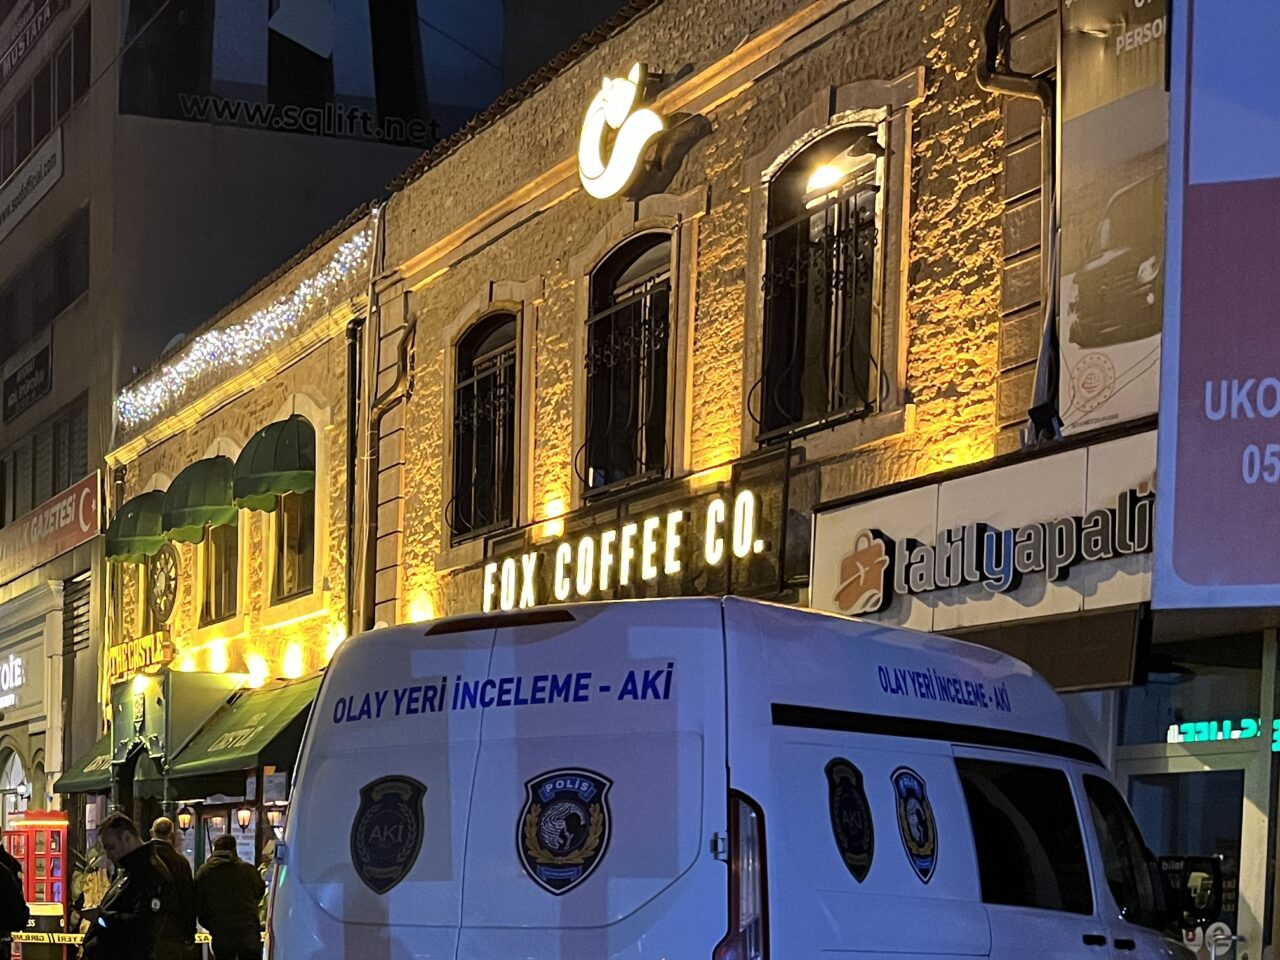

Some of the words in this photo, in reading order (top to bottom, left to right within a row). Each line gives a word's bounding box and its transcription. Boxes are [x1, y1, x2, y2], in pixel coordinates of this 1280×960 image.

[178, 92, 441, 141] www.sqlift.net
[1242, 443, 1280, 485] 05
[483, 552, 538, 612] FOX
[555, 510, 683, 600] COFFEE
[705, 490, 764, 565] CO.
[894, 480, 1155, 593] tatilyapali
[333, 690, 388, 724] OLAY
[394, 676, 447, 716] YERİ
[451, 672, 592, 711] İNCELEME
[618, 662, 674, 701] AKİ
[878, 665, 909, 696] OLAY
[908, 667, 937, 700] YERİ
[933, 669, 989, 708] İNCELEME
[993, 682, 1012, 713] AKİ
[545, 779, 589, 793] POLİS
